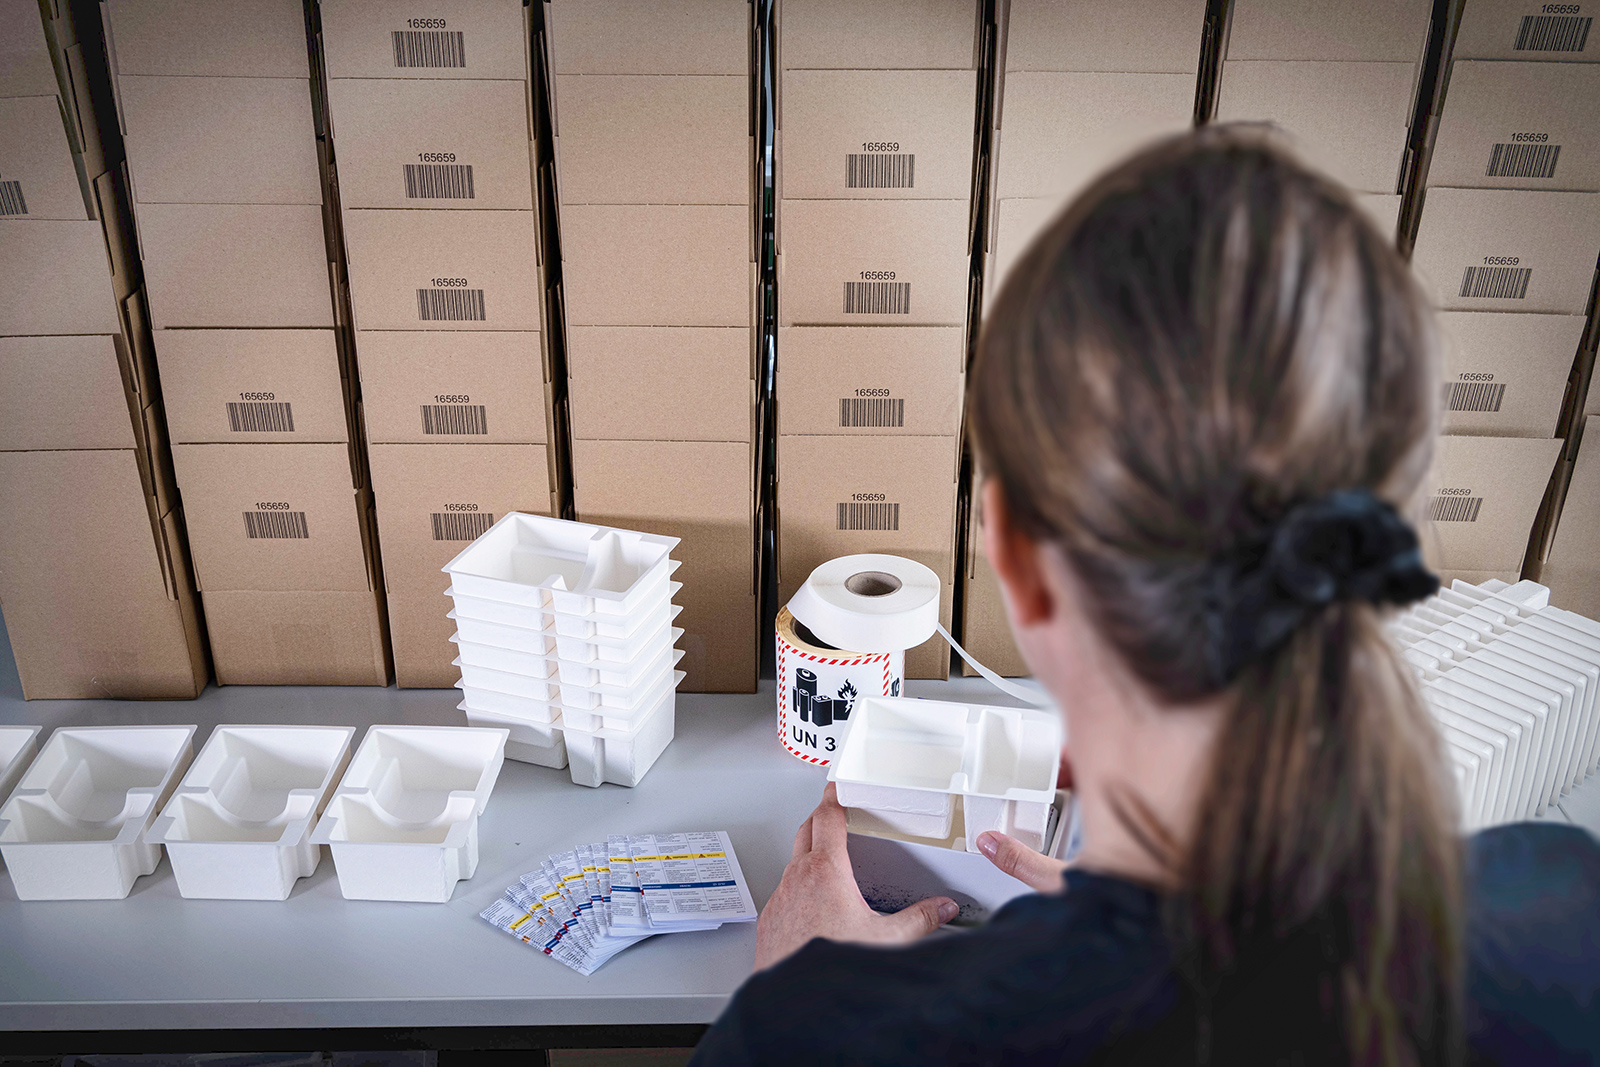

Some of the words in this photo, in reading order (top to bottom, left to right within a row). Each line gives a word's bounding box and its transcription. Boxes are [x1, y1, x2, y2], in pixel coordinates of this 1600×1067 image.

[1543, 4, 1581, 14] 165659
[407, 19, 447, 28] 165659
[1511, 133, 1549, 142] 165659
[862, 142, 900, 152] 165659
[418, 153, 456, 162] 165659
[1484, 257, 1520, 266] 165659
[859, 271, 896, 280] 165659
[431, 278, 468, 287] 165659
[1459, 373, 1495, 382] 165659
[239, 392, 275, 401] 165659
[855, 389, 890, 398] 165659
[434, 395, 470, 404] 165659
[1437, 488, 1472, 496] 165659
[851, 493, 886, 502] 165659
[255, 502, 290, 511] 165659
[444, 504, 479, 512] 165659
[792, 725, 817, 749] UN
[825, 736, 839, 752] 3
